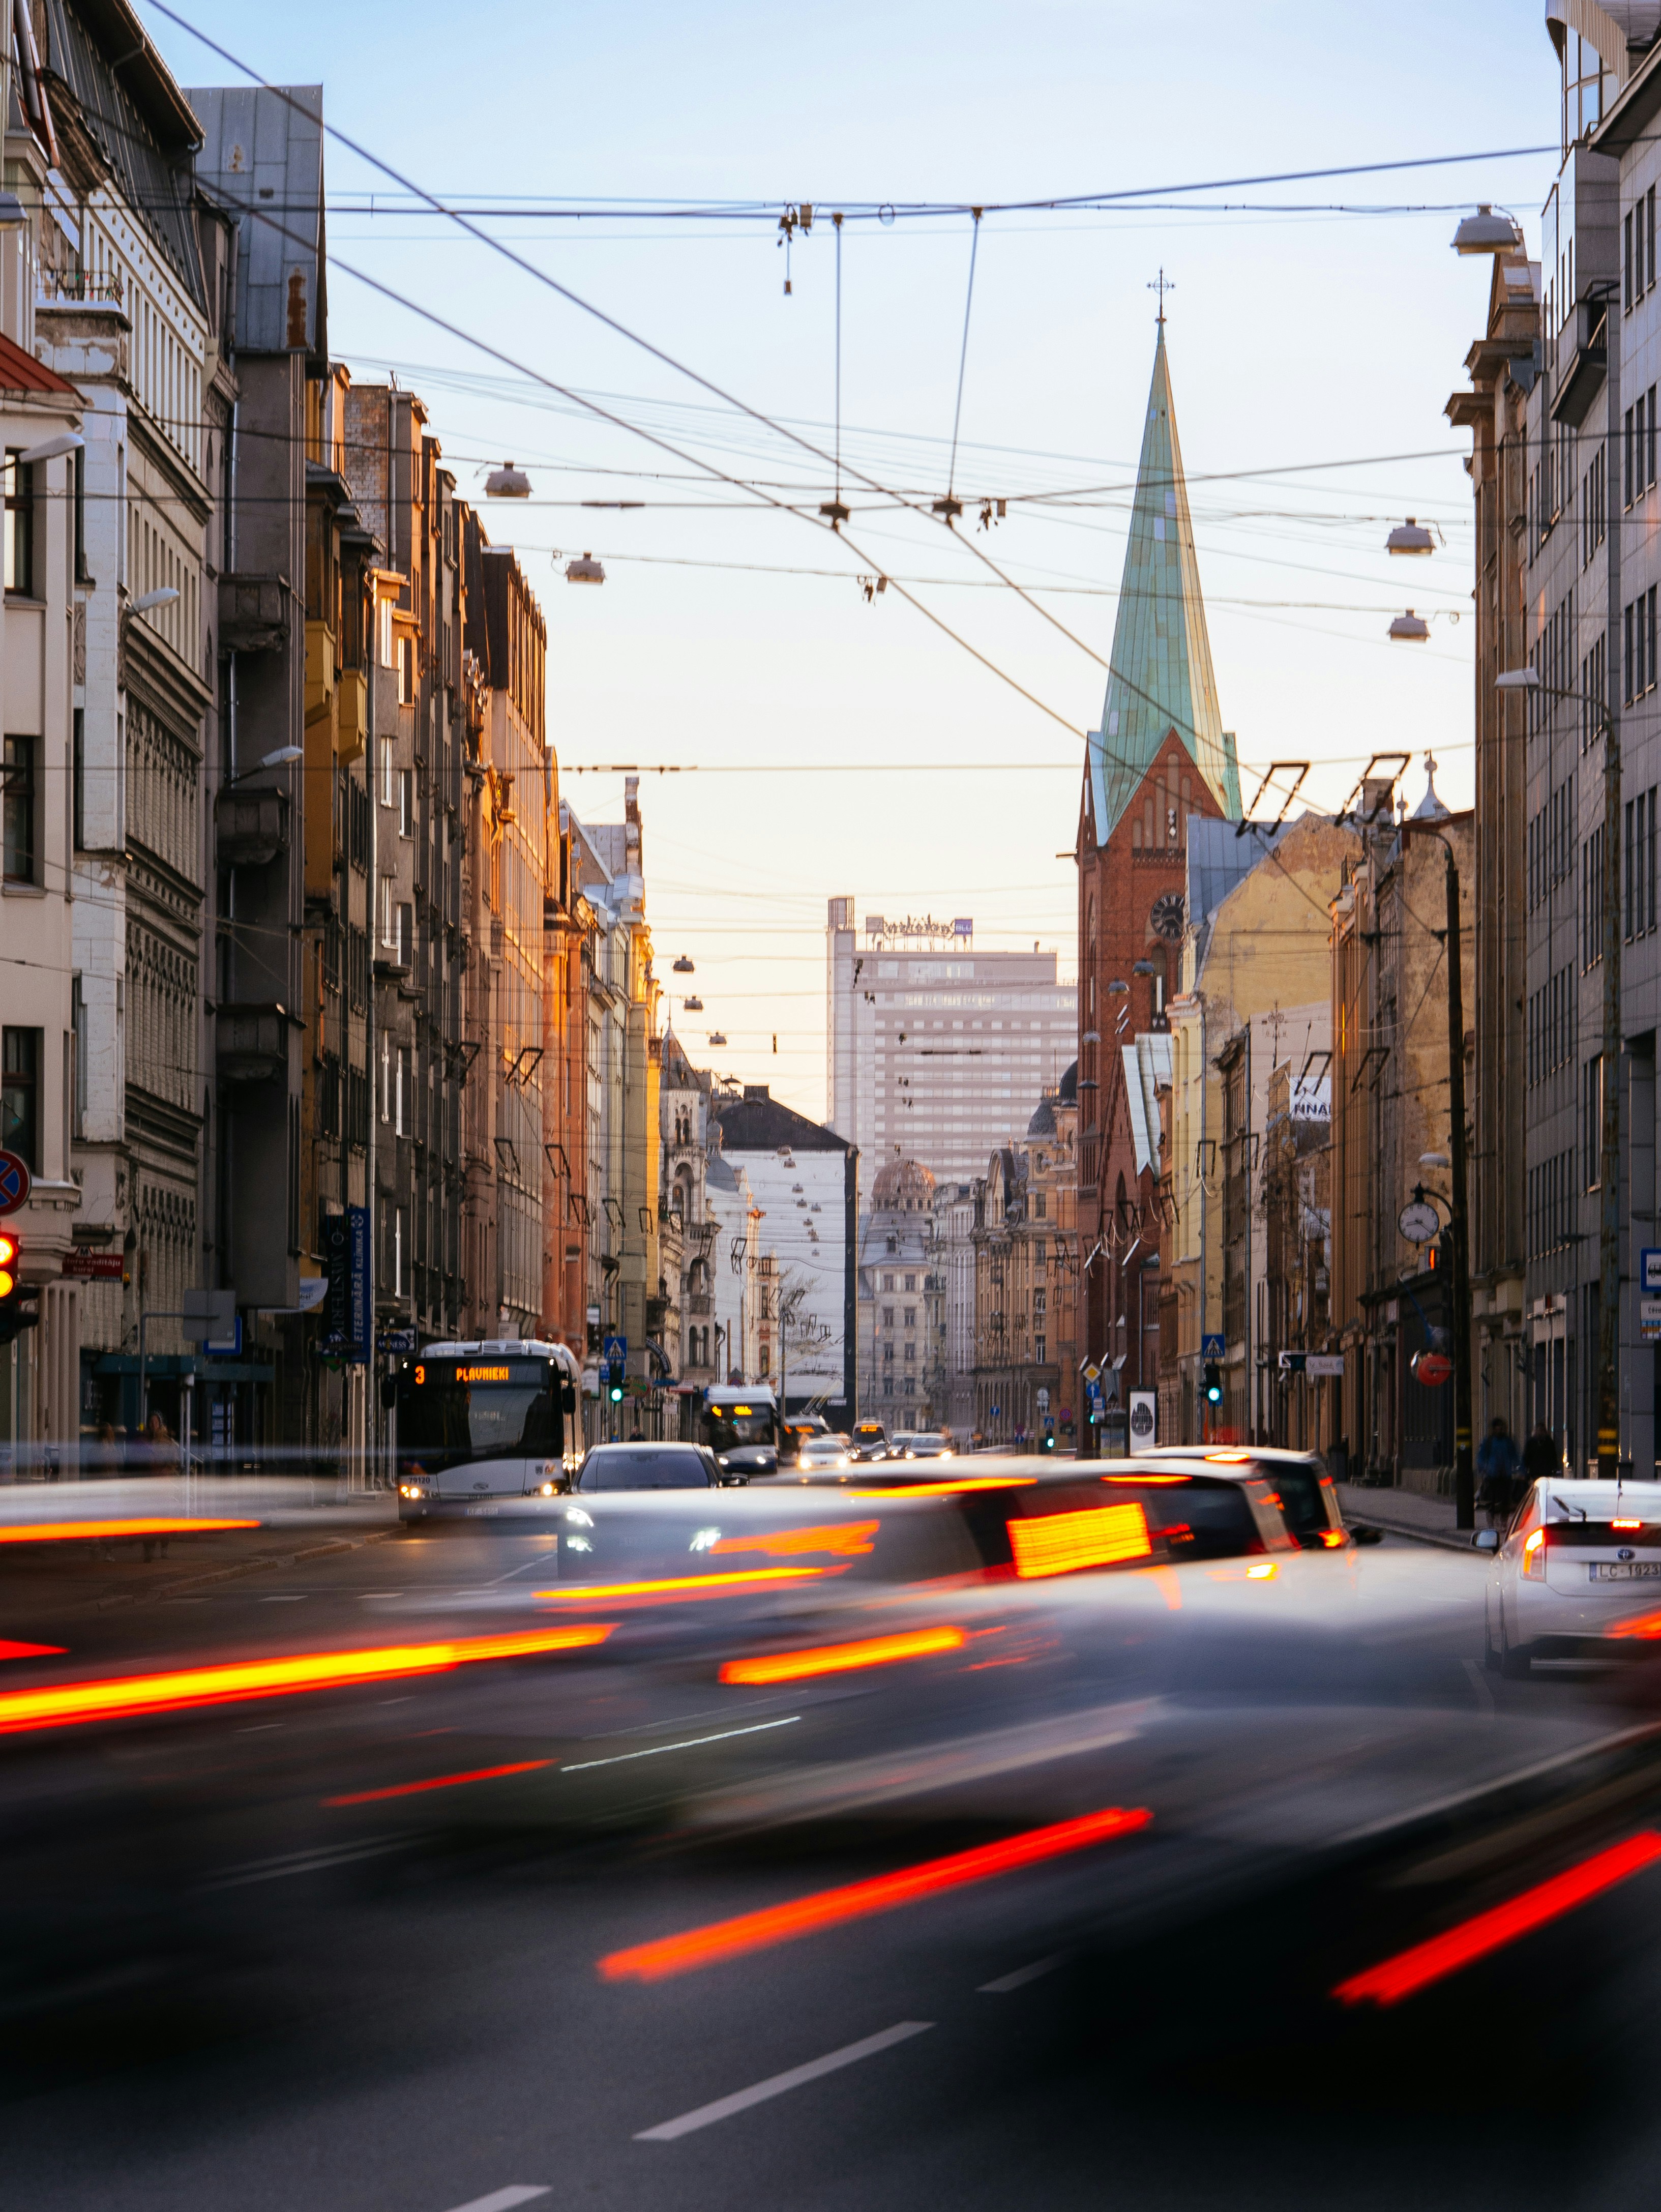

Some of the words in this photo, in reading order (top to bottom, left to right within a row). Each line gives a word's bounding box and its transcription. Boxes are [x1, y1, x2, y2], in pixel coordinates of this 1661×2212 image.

[80, 1248, 88, 1256] M
[353, 1229, 364, 1270] KLĪNIKA
[351, 1271, 364, 1343] ETERINĀRĀ
[415, 1365, 425, 1384] 3
[456, 1367, 509, 1382] PĻAVNIEKI
